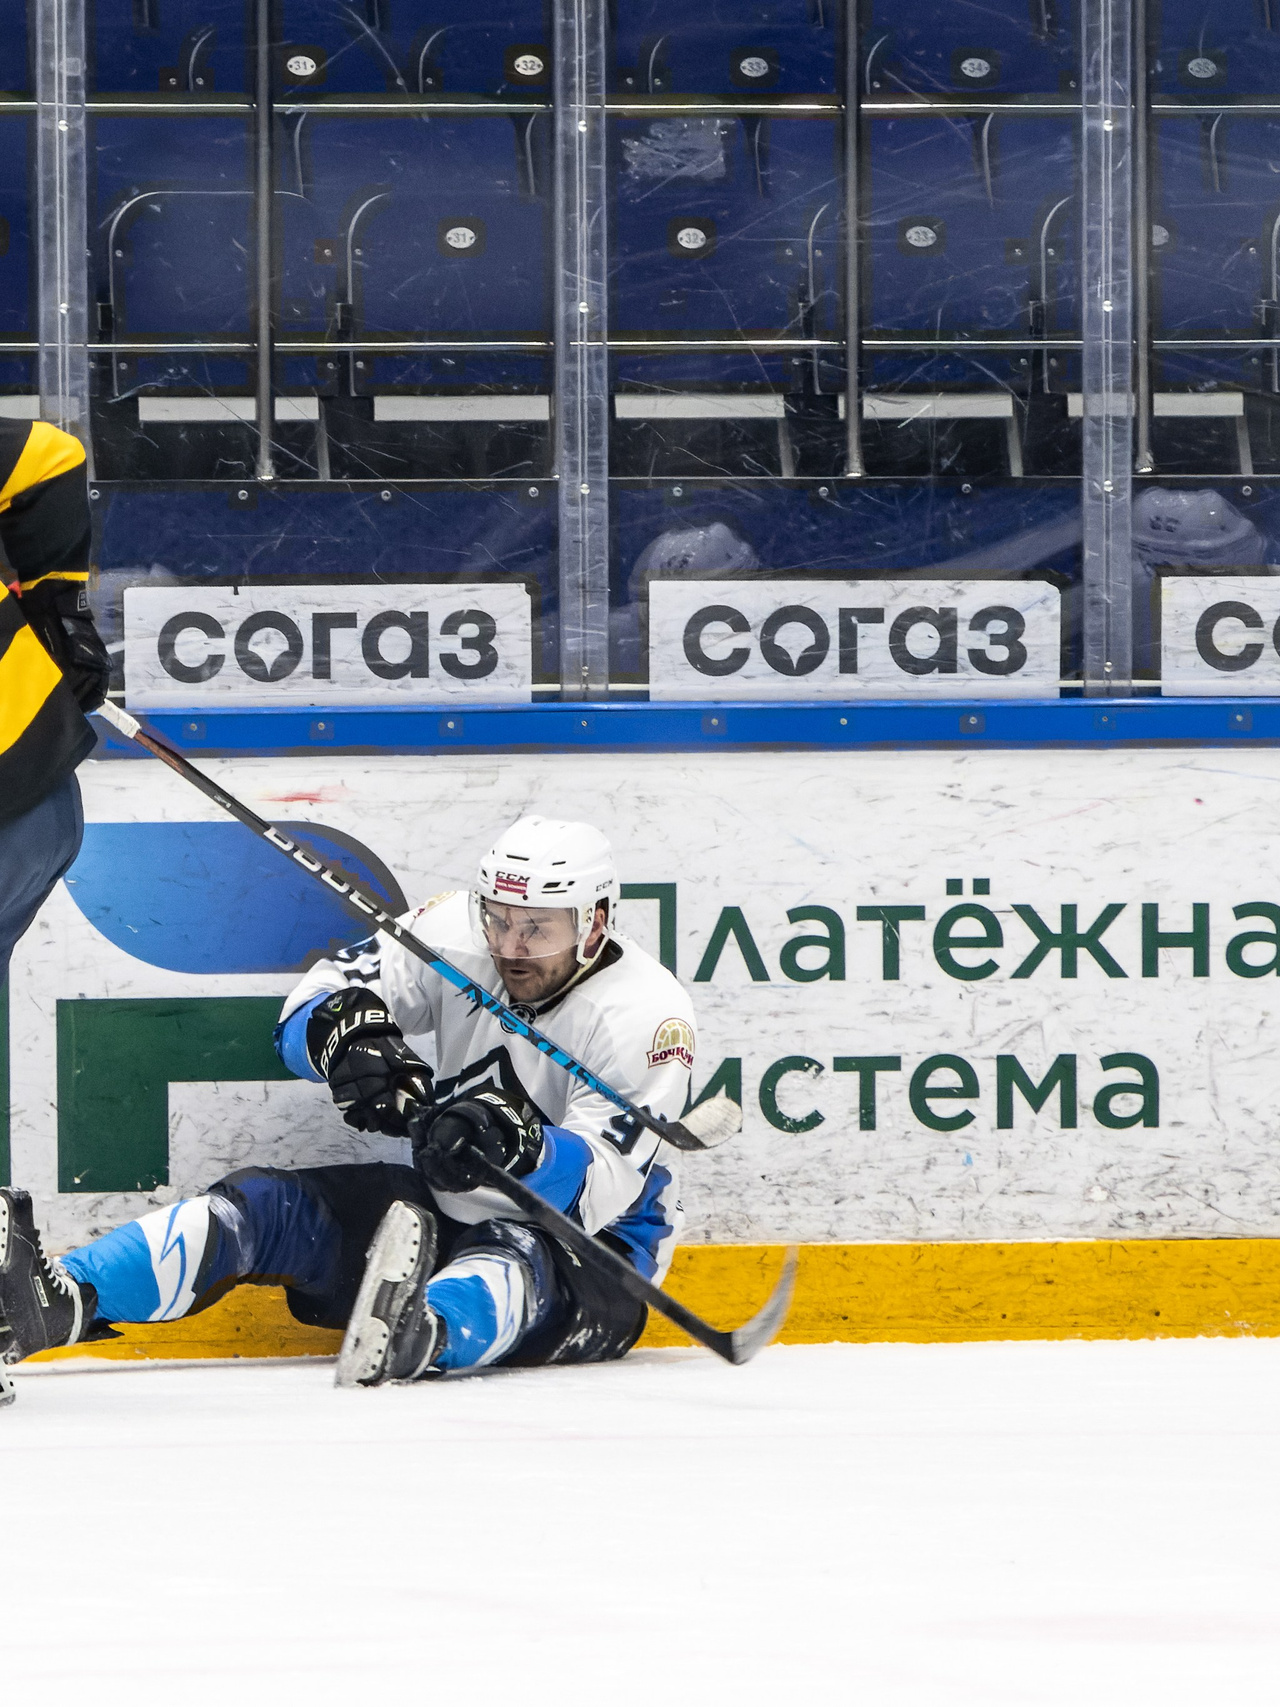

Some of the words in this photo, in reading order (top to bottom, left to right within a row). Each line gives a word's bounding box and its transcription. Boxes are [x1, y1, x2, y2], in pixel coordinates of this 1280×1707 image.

[496, 871, 531, 883] CCM
[595, 879, 614, 893] CCM
[463, 980, 590, 1084] NEXUS
[682, 1052, 1160, 1134] истема
